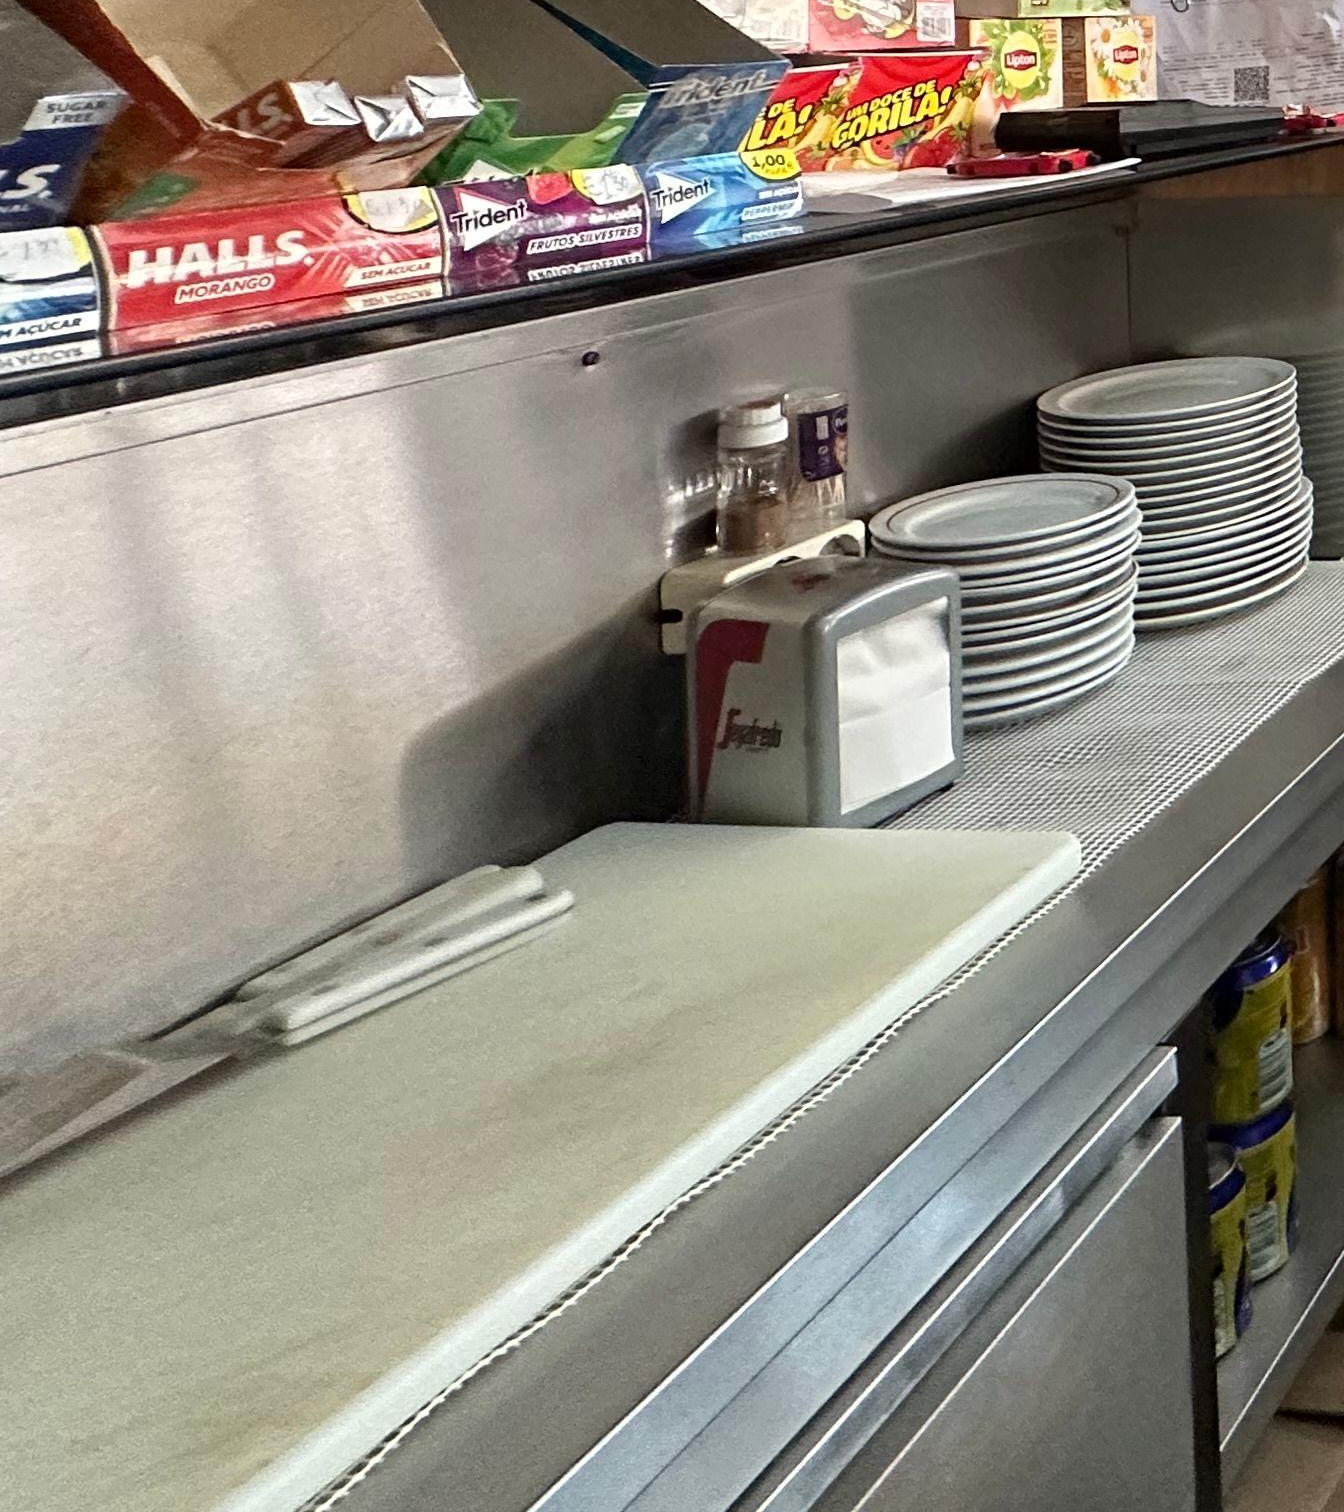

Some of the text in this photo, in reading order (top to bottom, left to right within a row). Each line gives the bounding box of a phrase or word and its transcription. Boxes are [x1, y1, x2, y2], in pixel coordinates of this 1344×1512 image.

[1006, 53, 1036, 67] Lipton
[1114, 49, 1138, 61] Lipton
[46, 100, 108, 115] SUGAR
[869, 87, 912, 115] DOCE
[914, 80, 937, 96] DE
[52, 113, 94, 124] FREE
[831, 86, 953, 150] GORILA!
[751, 154, 786, 169] 1,00
[651, 181, 710, 209] Trident
[449, 199, 529, 236] Trident
[529, 226, 641, 252] FRUTOS SILVESTRES
[360, 270, 384, 280] SEM
[178, 276, 272, 301] MORANGO
